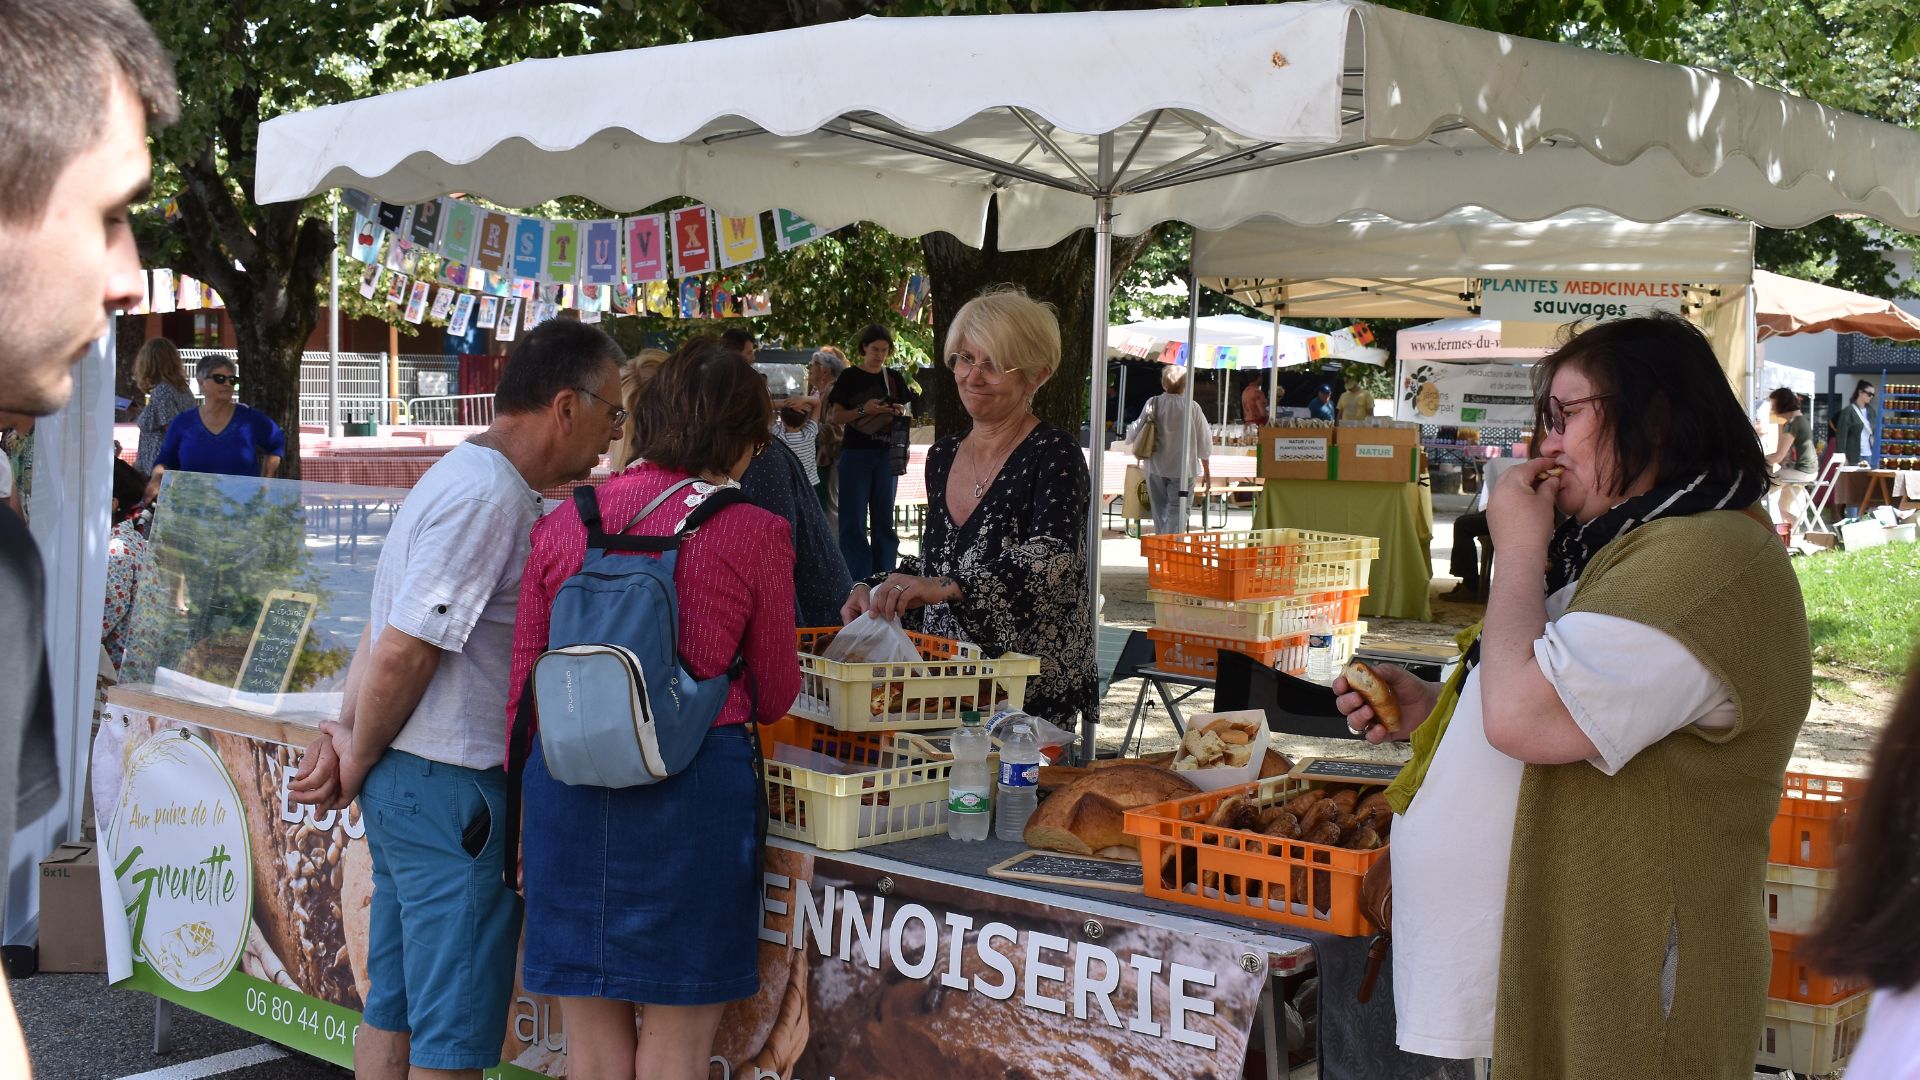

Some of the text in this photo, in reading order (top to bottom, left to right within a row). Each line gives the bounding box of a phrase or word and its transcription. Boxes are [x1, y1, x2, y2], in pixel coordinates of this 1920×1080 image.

[420, 200, 435, 223] P
[487, 223, 501, 248] R
[683, 223, 701, 249] X
[730, 216, 747, 240] W
[519, 231, 534, 255] S
[555, 235, 571, 261] T
[594, 239, 609, 265] U
[636, 231, 652, 257] V
[1482, 278, 1681, 298] PLANTES MEDICINALES
[1533, 300, 1627, 321] sauvages
[1358, 448, 1391, 456] NATUR
[128, 799, 227, 835] Aux pains de la
[42, 866, 71, 879] 6x1L
[114, 844, 240, 957] Grenette
[246, 987, 267, 1016] 06
[271, 996, 293, 1025] 80
[297, 1006, 319, 1035] 44
[324, 1015, 347, 1045] 04
